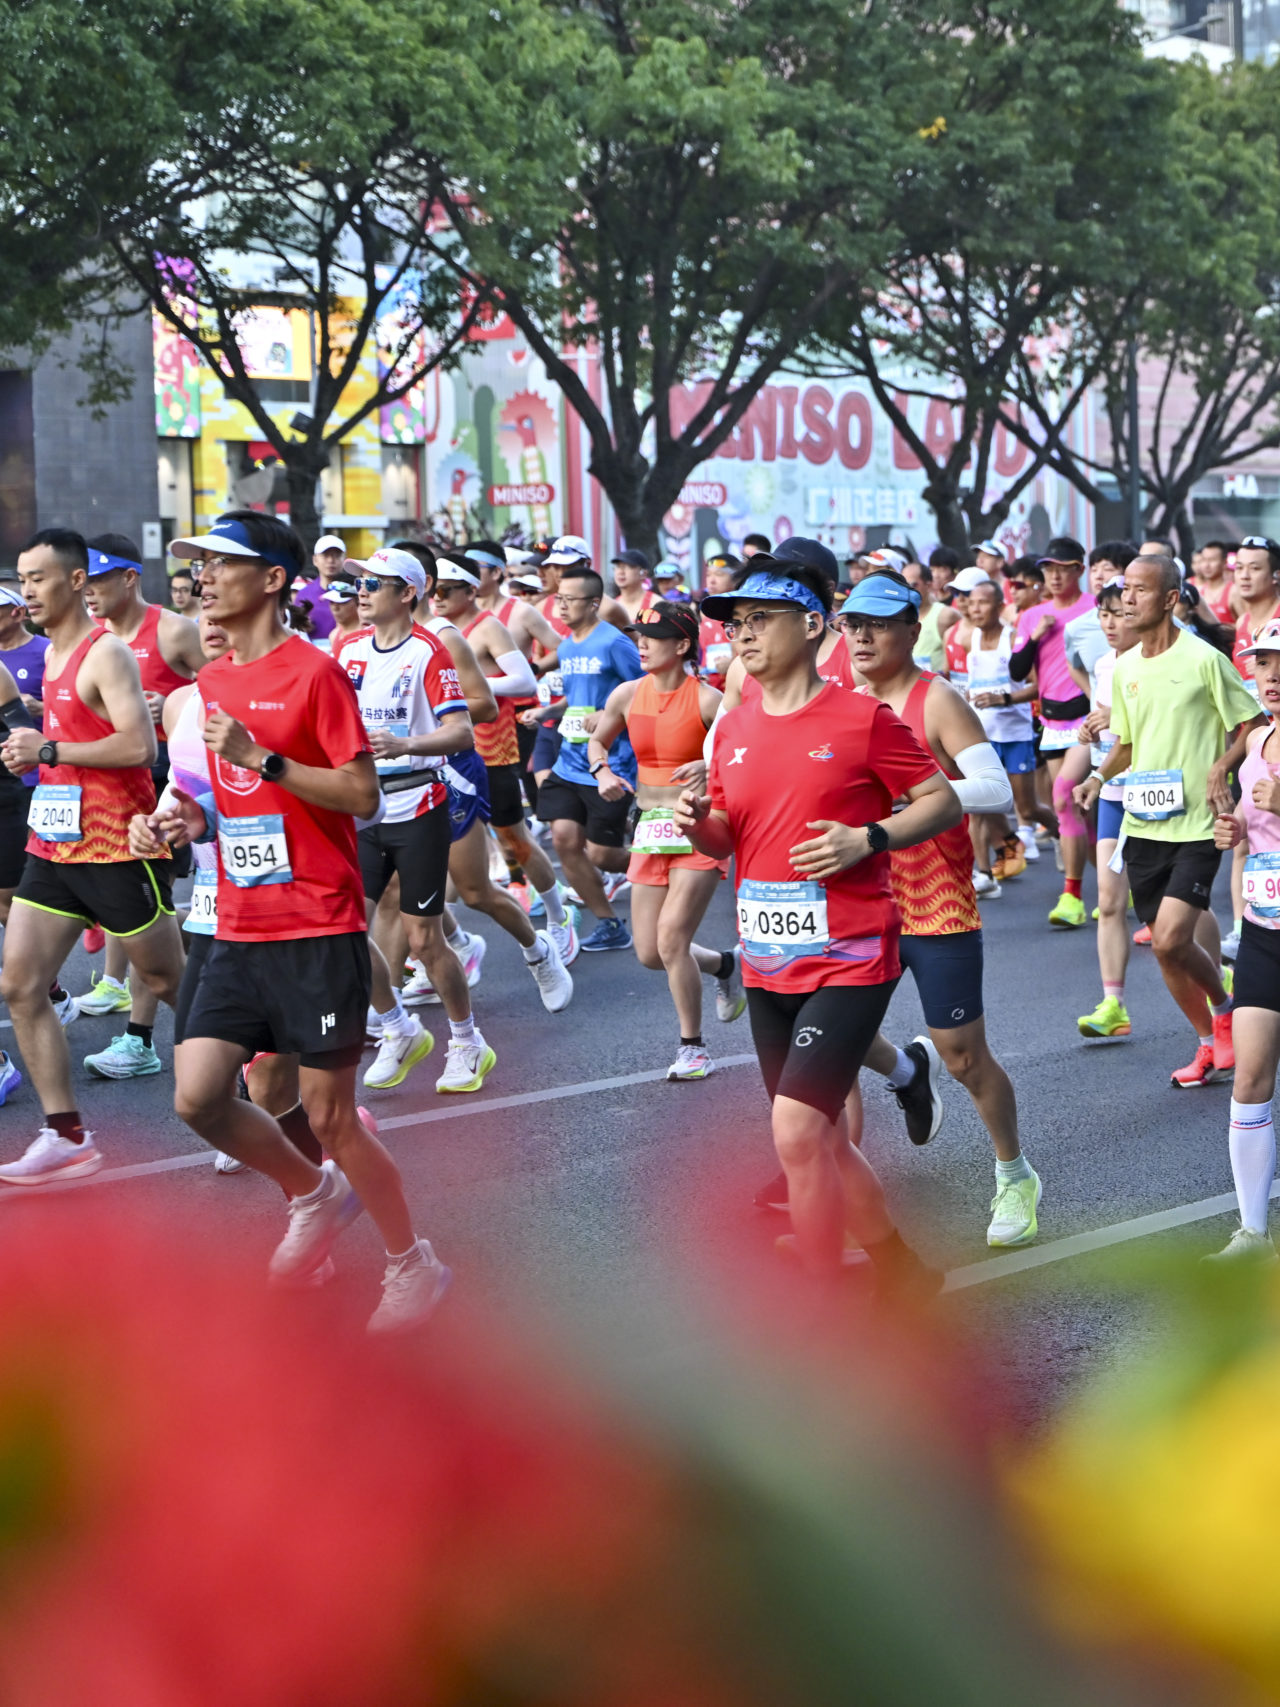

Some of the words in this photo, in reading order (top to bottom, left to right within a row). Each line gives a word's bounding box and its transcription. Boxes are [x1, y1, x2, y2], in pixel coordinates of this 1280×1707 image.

[893, 391, 1029, 477] LAD
[493, 485, 550, 505] MINISO
[1128, 792, 1135, 802] D
[1140, 789, 1175, 807] 1004
[42, 807, 73, 827] 2040
[646, 821, 684, 839] 799
[1247, 879, 1255, 893] D
[740, 908, 748, 923] D
[758, 910, 817, 936] 0364
